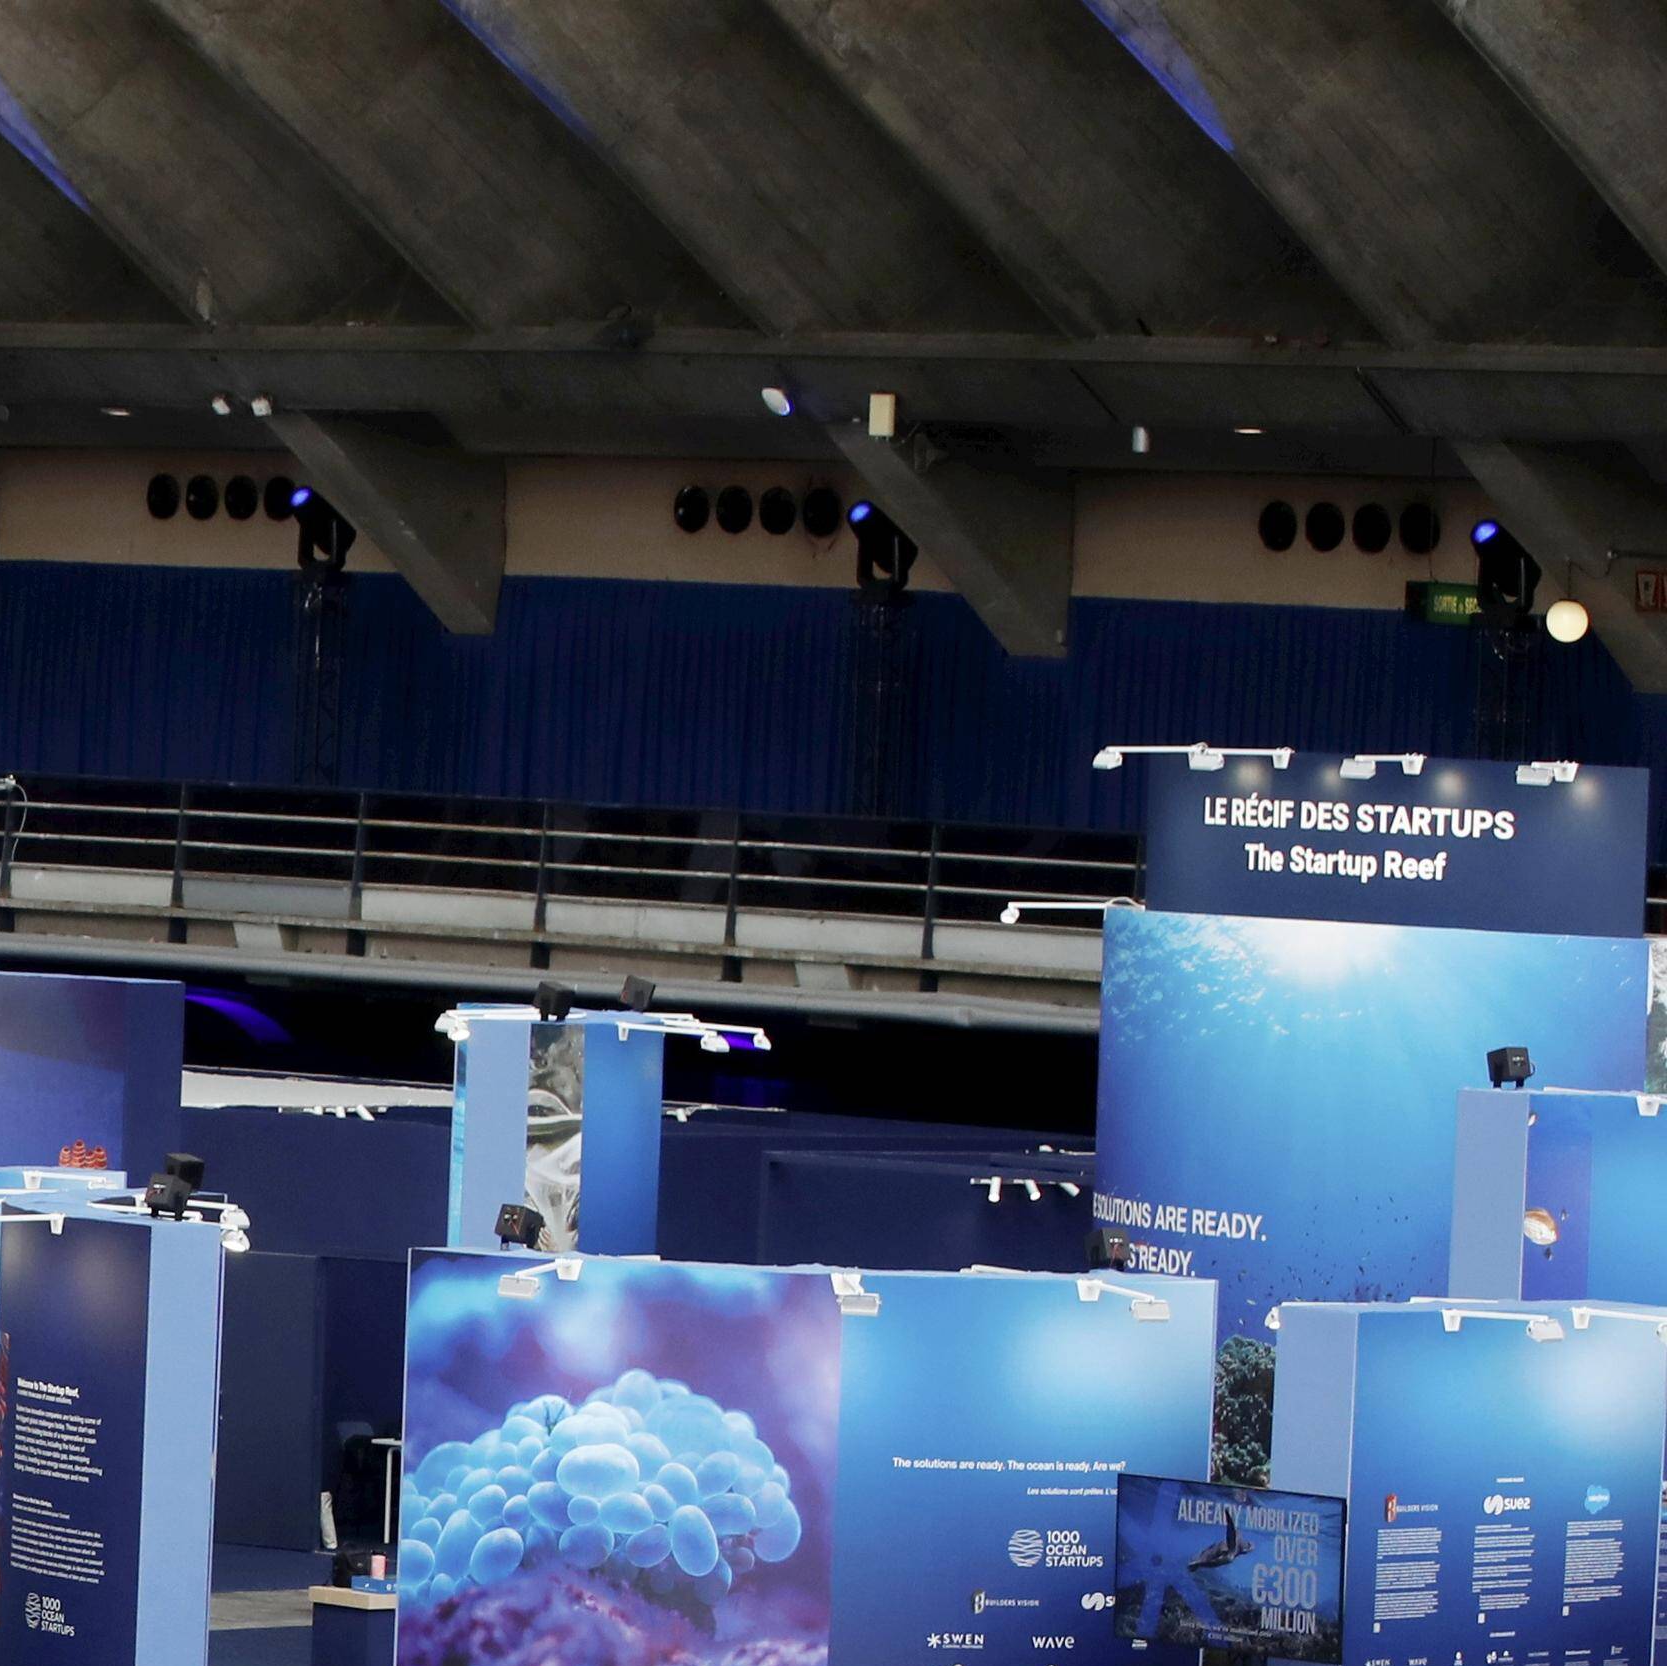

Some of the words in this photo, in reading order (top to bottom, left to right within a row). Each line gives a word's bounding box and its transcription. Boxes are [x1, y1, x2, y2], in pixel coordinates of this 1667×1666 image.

[1204, 796, 1227, 825] LE
[1231, 792, 1294, 829] RÉCIF
[1300, 801, 1349, 832] DES
[1356, 803, 1515, 840] STARTUPS
[1245, 842, 1283, 871] The
[1290, 845, 1377, 883] Startup
[1384, 850, 1447, 881] Reef
[1097, 1194, 1152, 1230] SOLUTIONS
[1154, 1204, 1187, 1233] ARE
[1192, 1208, 1267, 1242] READY.
[1139, 1245, 1196, 1277] READY.
[893, 1457, 911, 1468] The
[914, 1458, 957, 1470] solutions
[959, 1461, 975, 1470] are
[976, 1460, 1005, 1472] ready.
[1008, 1460, 1024, 1471] The
[1026, 1462, 1055, 1471] ocean
[1092, 1462, 1107, 1471] Are
[1109, 1461, 1126, 1471] we?
[1178, 1498, 1242, 1528] ALREADY
[1245, 1505, 1320, 1537] MOBILIZED
[1046, 1530, 1080, 1544] 1000
[1045, 1544, 1087, 1556] OCEAN
[1274, 1535, 1319, 1568] OVER
[1045, 1556, 1104, 1568] STARTUPS
[1251, 1562, 1317, 1610] €300
[41, 1596, 61, 1611] 1000
[41, 1609, 65, 1624] OCEAN
[1260, 1606, 1317, 1636] MILLION
[41, 1620, 75, 1637] STARTUPS
[942, 1632, 984, 1645] SWEN
